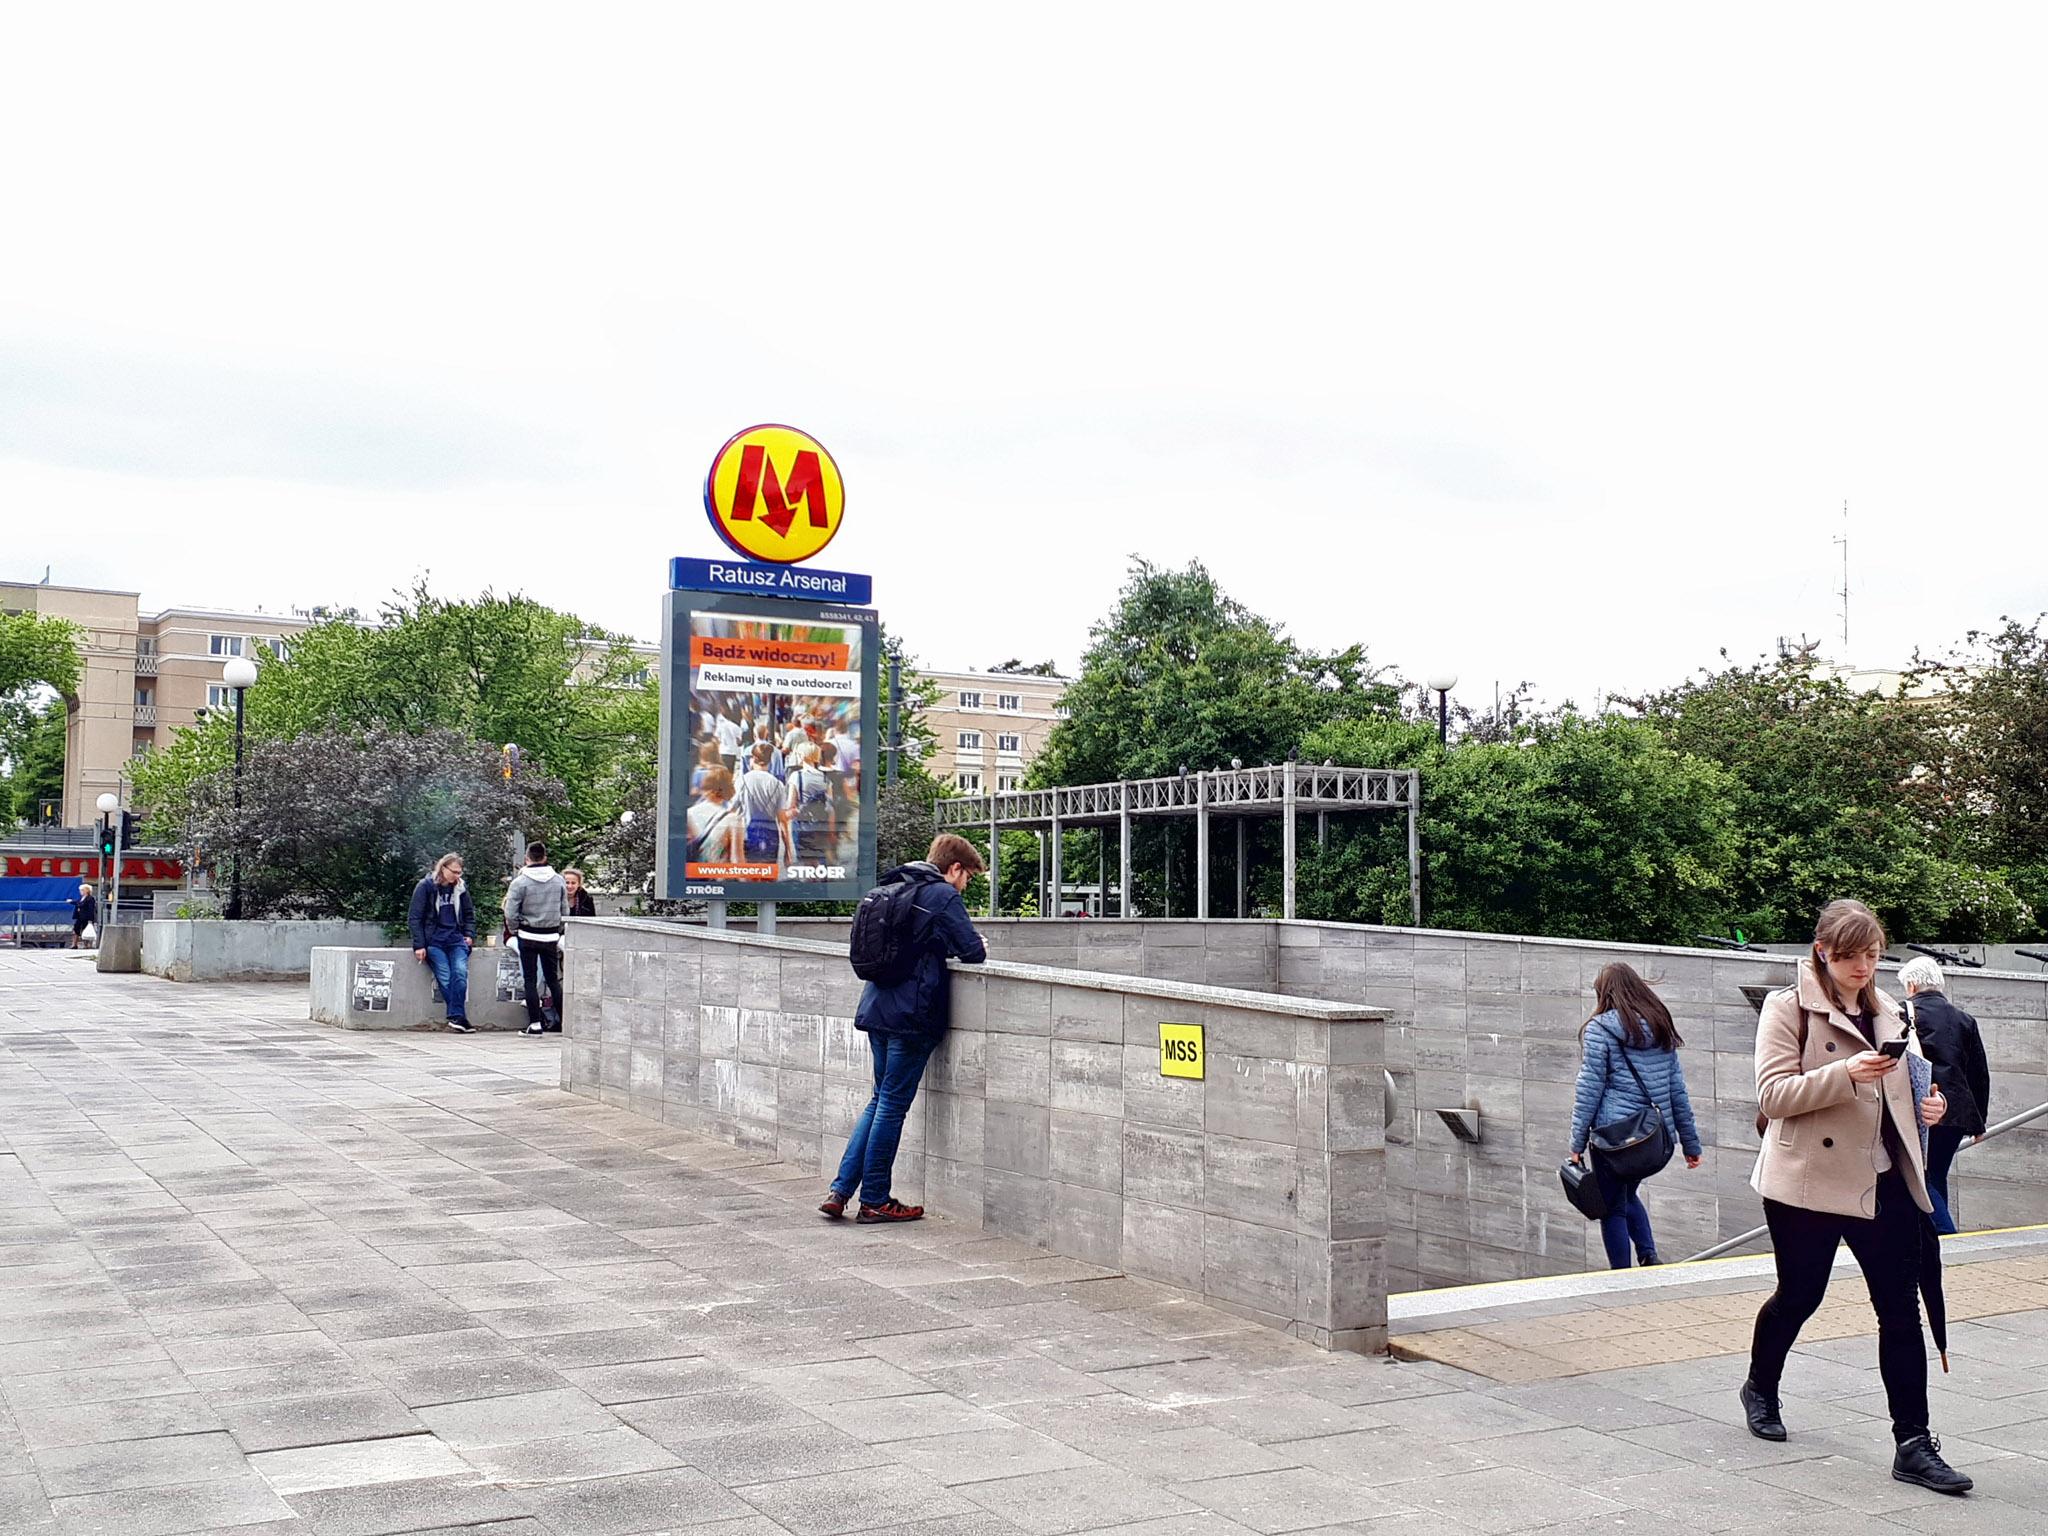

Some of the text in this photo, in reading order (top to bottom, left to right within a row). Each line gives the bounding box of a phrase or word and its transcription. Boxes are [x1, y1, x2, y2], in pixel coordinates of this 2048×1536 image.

[730, 444, 828, 539] M
[709, 564, 847, 593] Ratusz Arsenał
[702, 642, 836, 668] Bądź widoczny!
[704, 671, 853, 690] Reklamuj się na outdoorze!
[697, 866, 772, 876] www.stroer.pl
[1164, 1039, 1198, 1062] MSS
